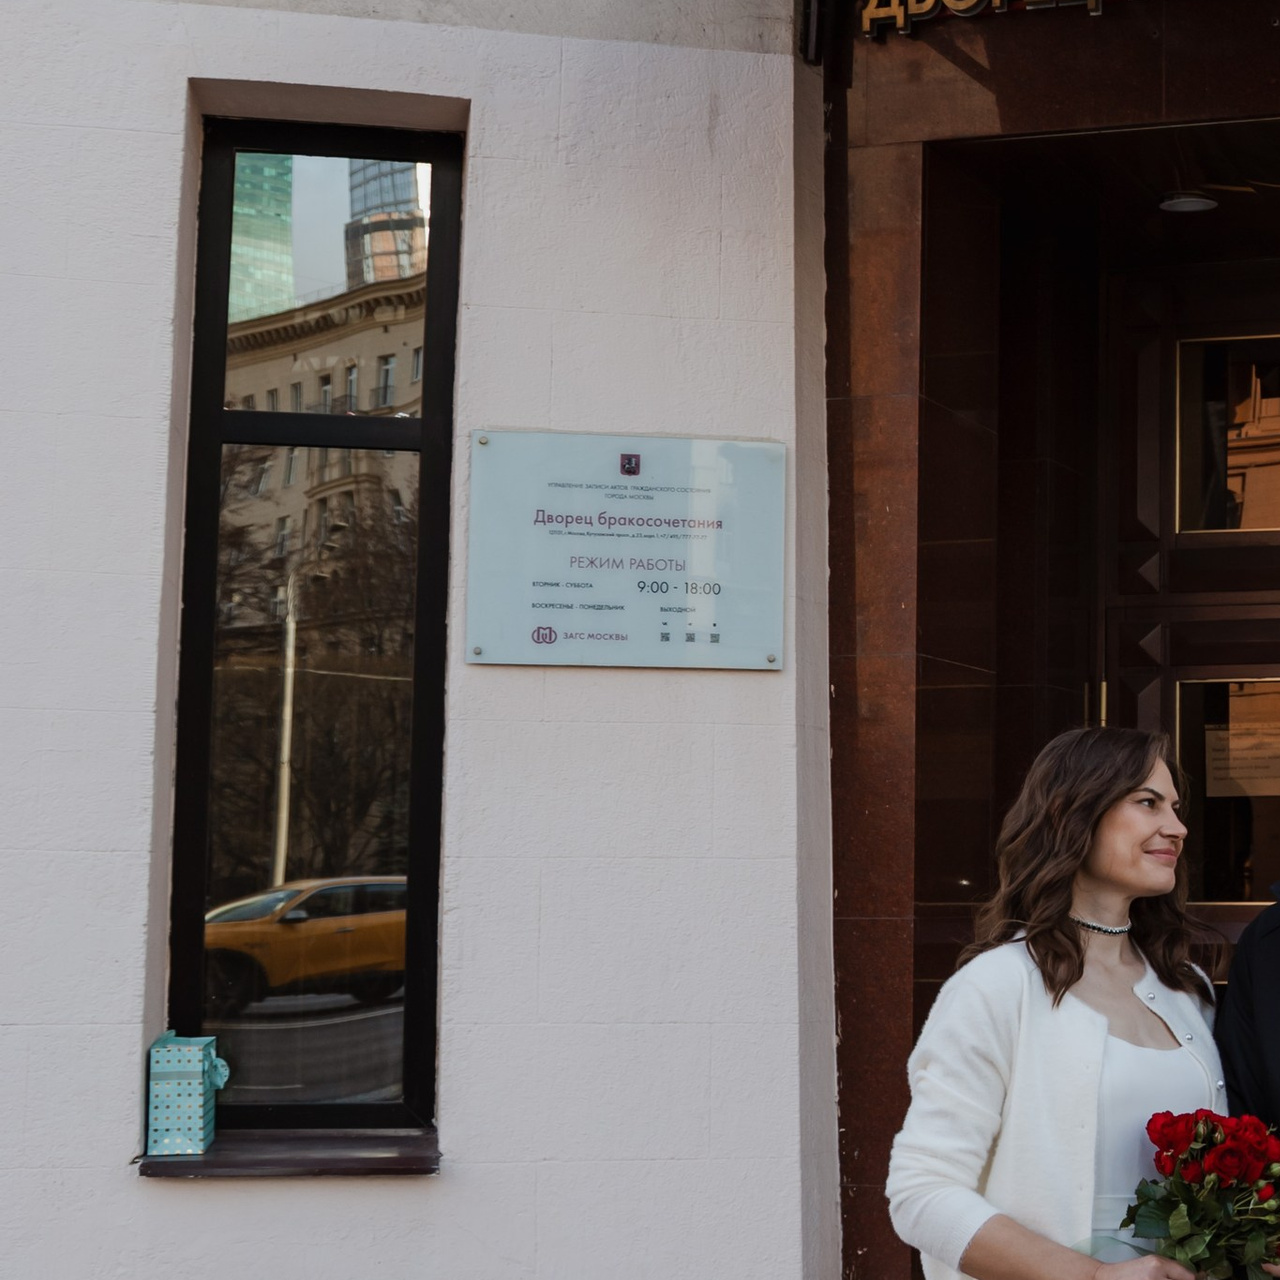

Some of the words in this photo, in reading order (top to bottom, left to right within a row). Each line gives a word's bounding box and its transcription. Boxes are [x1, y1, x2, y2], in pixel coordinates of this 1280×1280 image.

[534, 509, 593, 527] Дворец
[598, 511, 723, 530] бракосочетания
[569, 556, 624, 569] РЕЖИМ
[629, 558, 686, 571] РАБОТЫ
[637, 580, 669, 594] 9:00
[684, 582, 721, 595] 18:00
[531, 602, 574, 610] ВОСКРЕСЕНЬЕ
[563, 632, 585, 640] ЗАГС
[586, 632, 628, 641] МОСКВЫ
